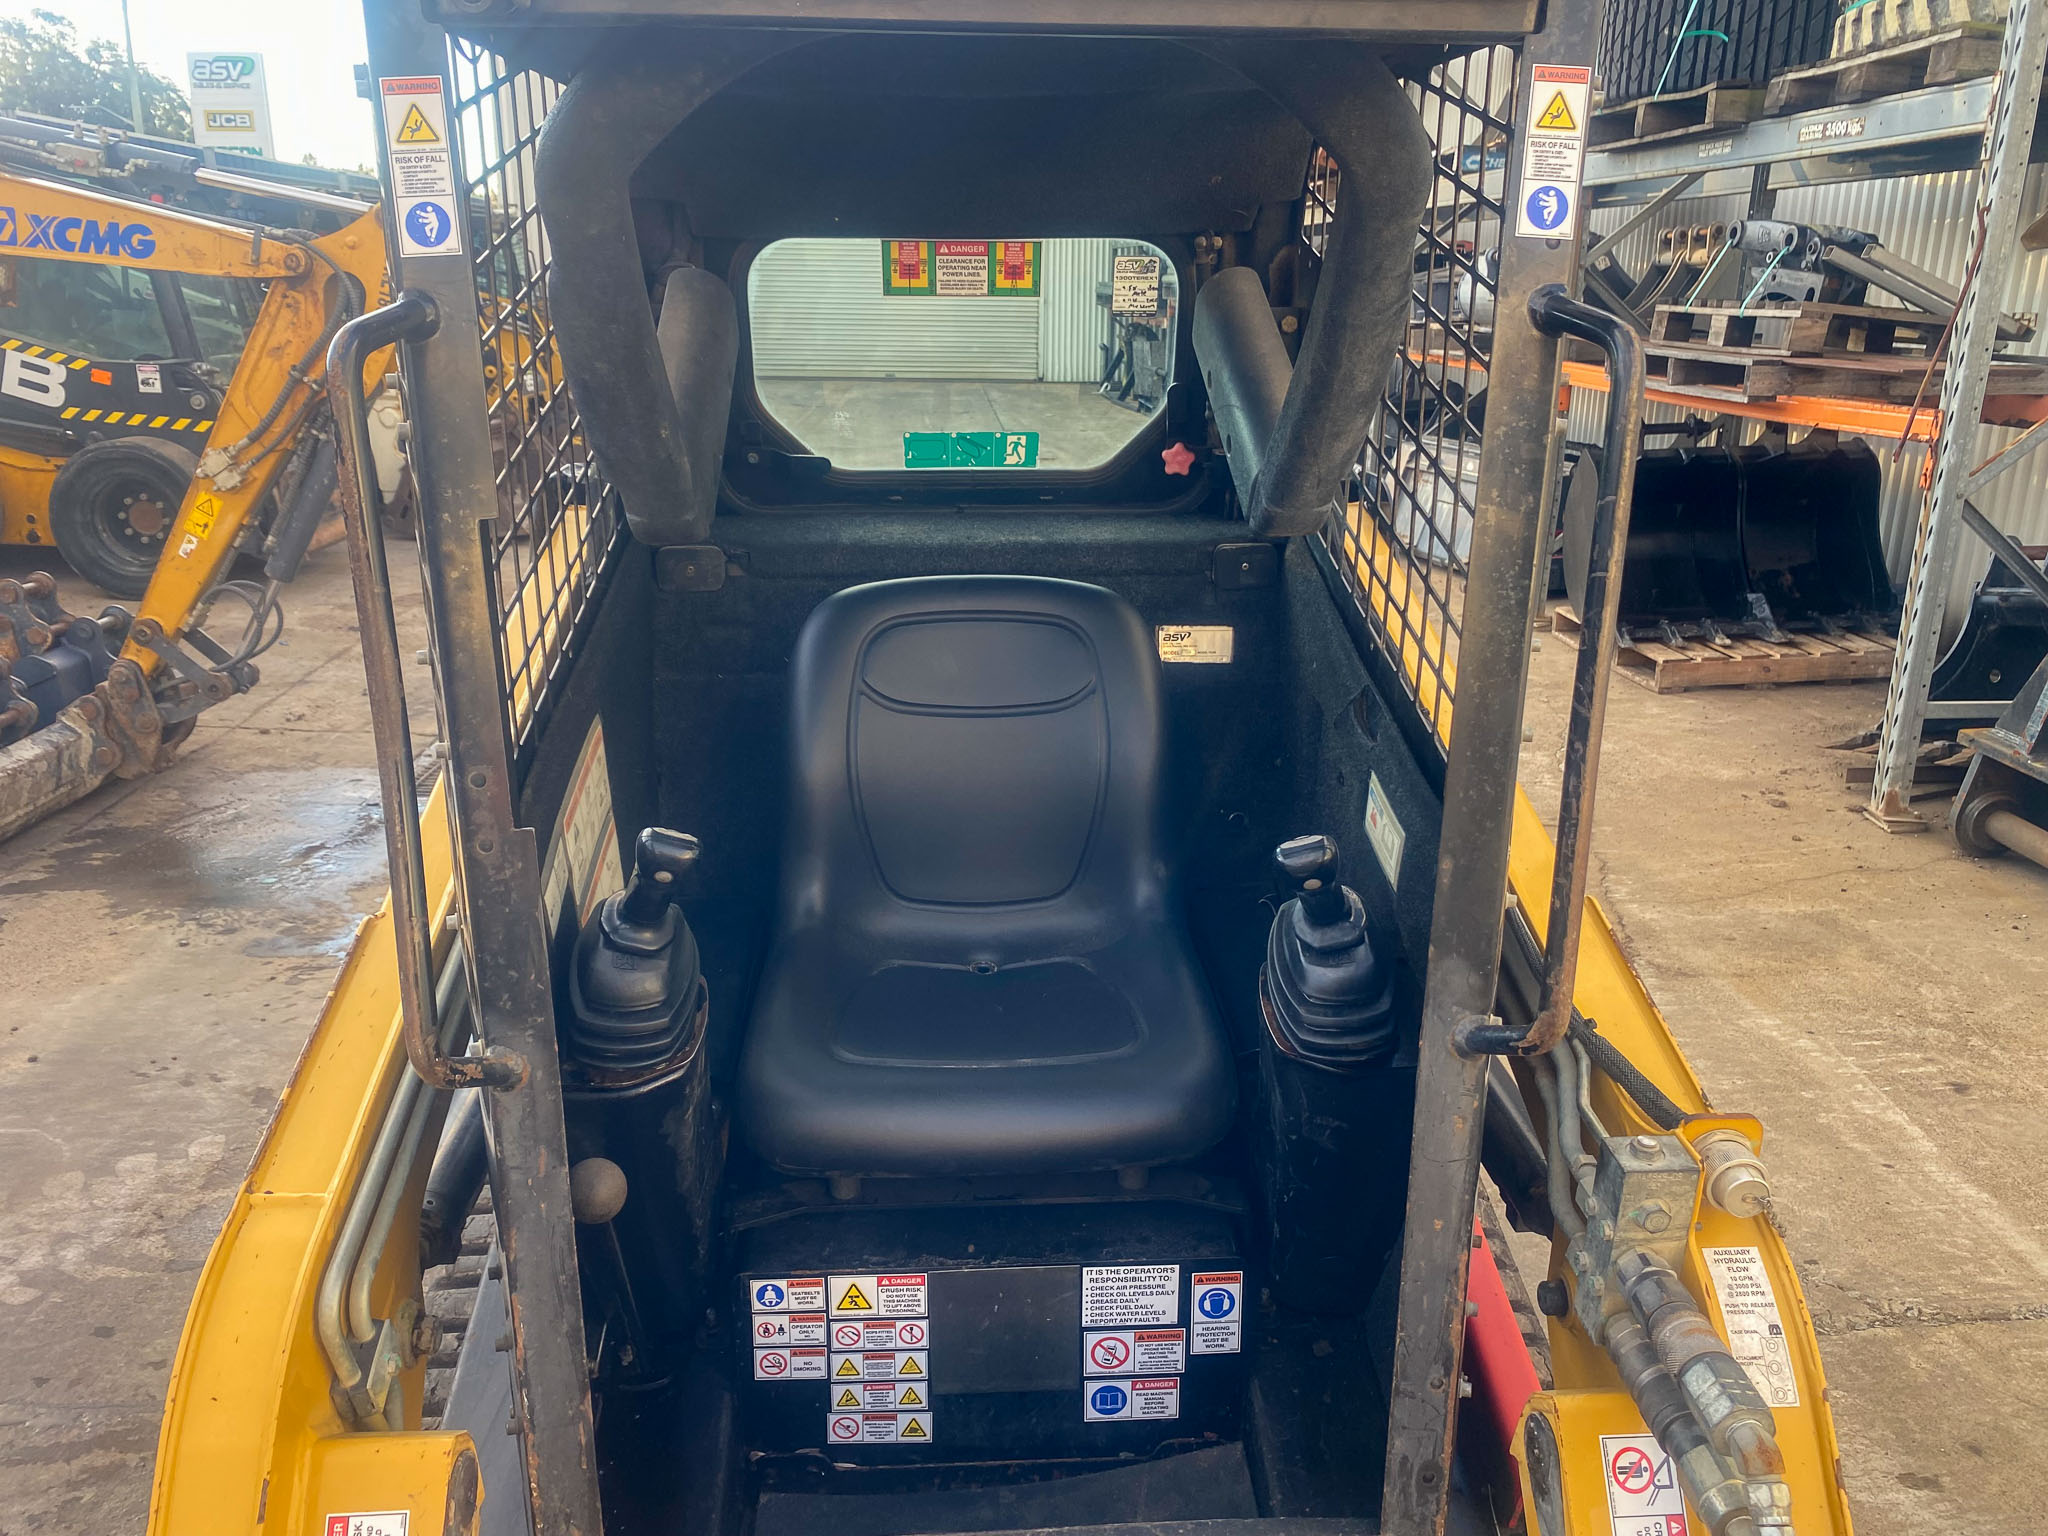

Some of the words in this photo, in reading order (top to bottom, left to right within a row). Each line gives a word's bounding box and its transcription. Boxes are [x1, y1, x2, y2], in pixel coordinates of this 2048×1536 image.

[192, 58, 249, 81] asv
[1547, 71, 1586, 80] WARNING
[396, 82, 438, 91] WARNING
[207, 113, 250, 128] JCB
[1530, 140, 1547, 149] RISK
[1548, 141, 1558, 149] OF
[1559, 142, 1577, 150] FALL.
[395, 156, 413, 164] RISK
[413, 155, 424, 164] OF
[425, 154, 446, 163] FALL.
[19, 213, 156, 259] XCMG
[950, 245, 985, 253] DANGER
[1116, 259, 1142, 271] asv
[1163, 632, 1191, 642] asv
[1123, 1267, 1175, 1275] OPERATOR'S
